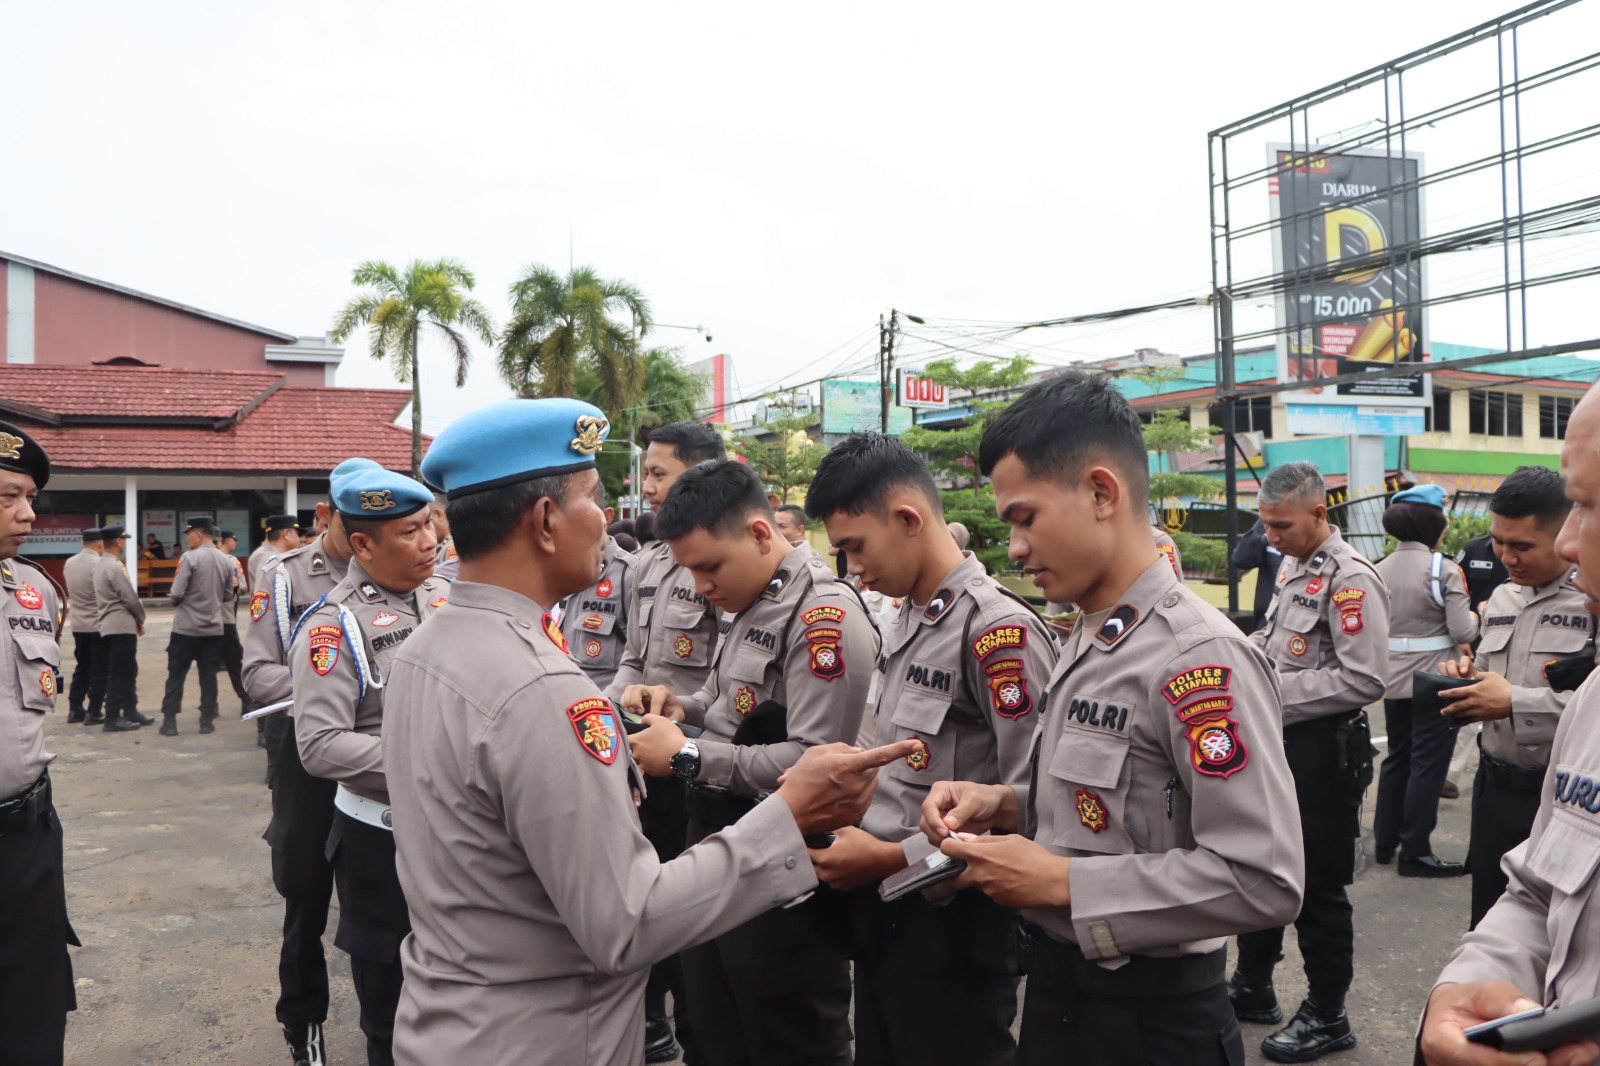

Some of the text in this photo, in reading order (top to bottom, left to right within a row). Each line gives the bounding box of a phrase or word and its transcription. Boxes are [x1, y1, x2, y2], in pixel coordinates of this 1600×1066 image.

[1322, 182, 1377, 197] DJARUM
[1314, 296, 1372, 317] 15.000
[908, 379, 942, 400] 110
[583, 600, 616, 613] POLRI
[1292, 594, 1318, 610] POLRI
[804, 607, 842, 619] POLRES
[1540, 614, 1588, 629] POLRI
[9, 616, 53, 633] POLRI
[744, 627, 776, 650] POLRI
[975, 628, 1020, 651] POLRES
[978, 636, 1020, 656] KETAPANG
[906, 664, 950, 692] POLRI
[1169, 668, 1222, 691] POLRES
[1173, 677, 1222, 698] KETAPANG
[573, 700, 604, 713] PROPAM
[1067, 698, 1128, 731] POLRI
